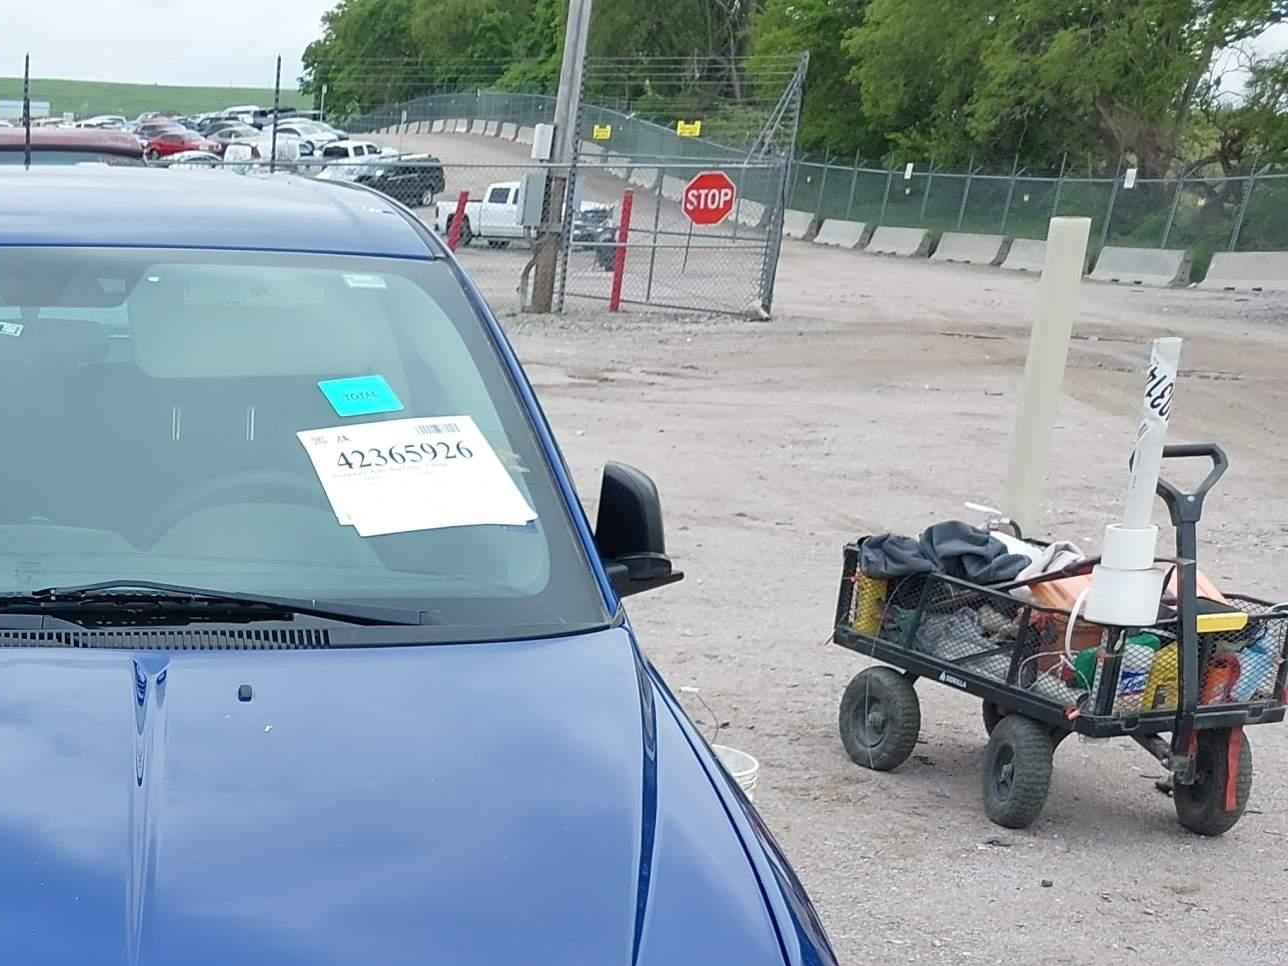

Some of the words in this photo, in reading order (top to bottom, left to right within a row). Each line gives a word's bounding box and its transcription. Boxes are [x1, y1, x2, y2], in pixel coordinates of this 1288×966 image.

[686, 188, 732, 210] STOP
[343, 391, 380, 401] TOTAL
[337, 440, 474, 469] 42365926
